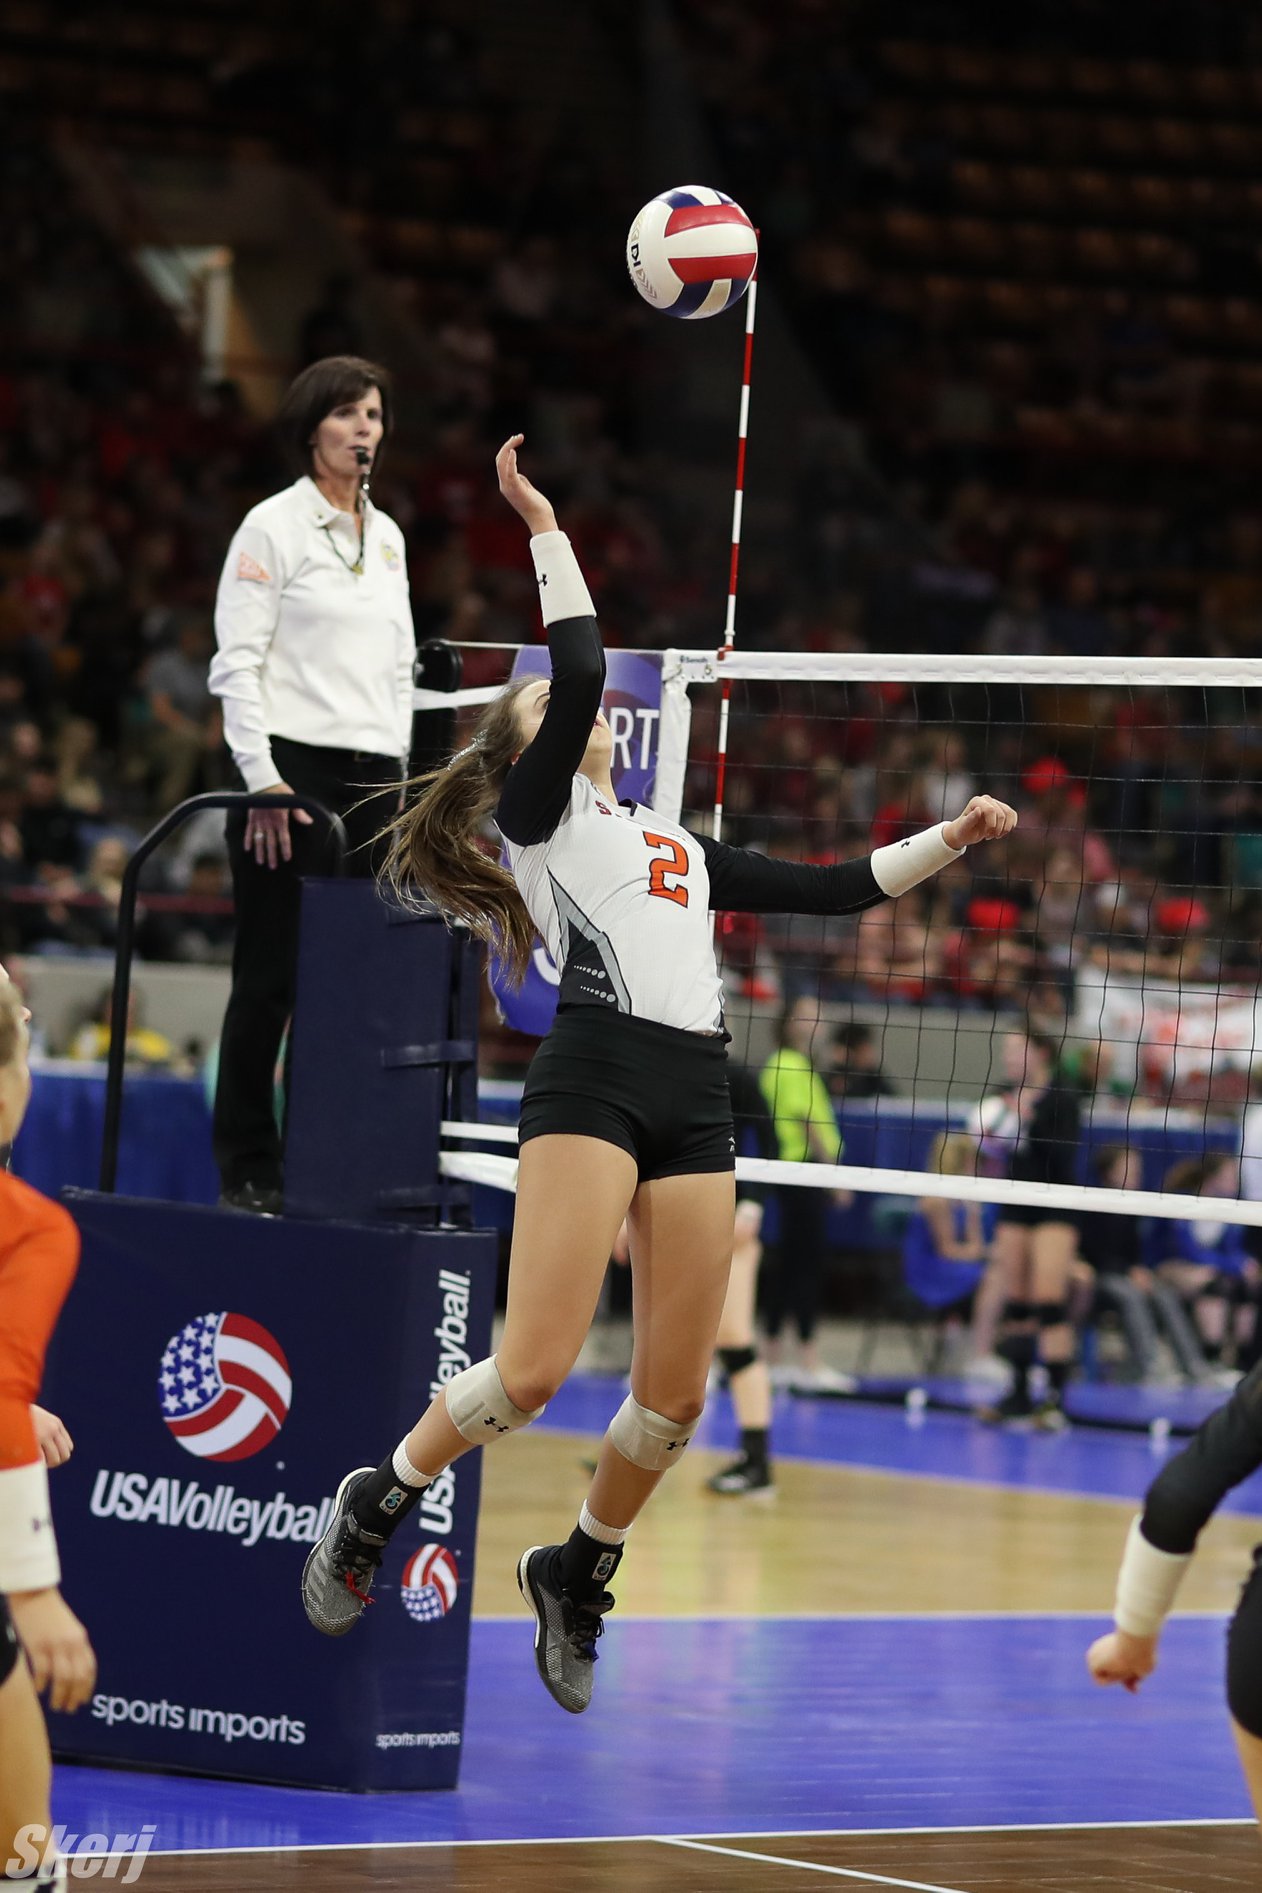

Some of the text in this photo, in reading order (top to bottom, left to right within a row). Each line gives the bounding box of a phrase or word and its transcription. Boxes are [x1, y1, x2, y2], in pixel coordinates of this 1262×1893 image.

[601, 706, 660, 770] RT
[642, 830, 690, 909] 2
[91, 1693, 307, 1746] sports imports
